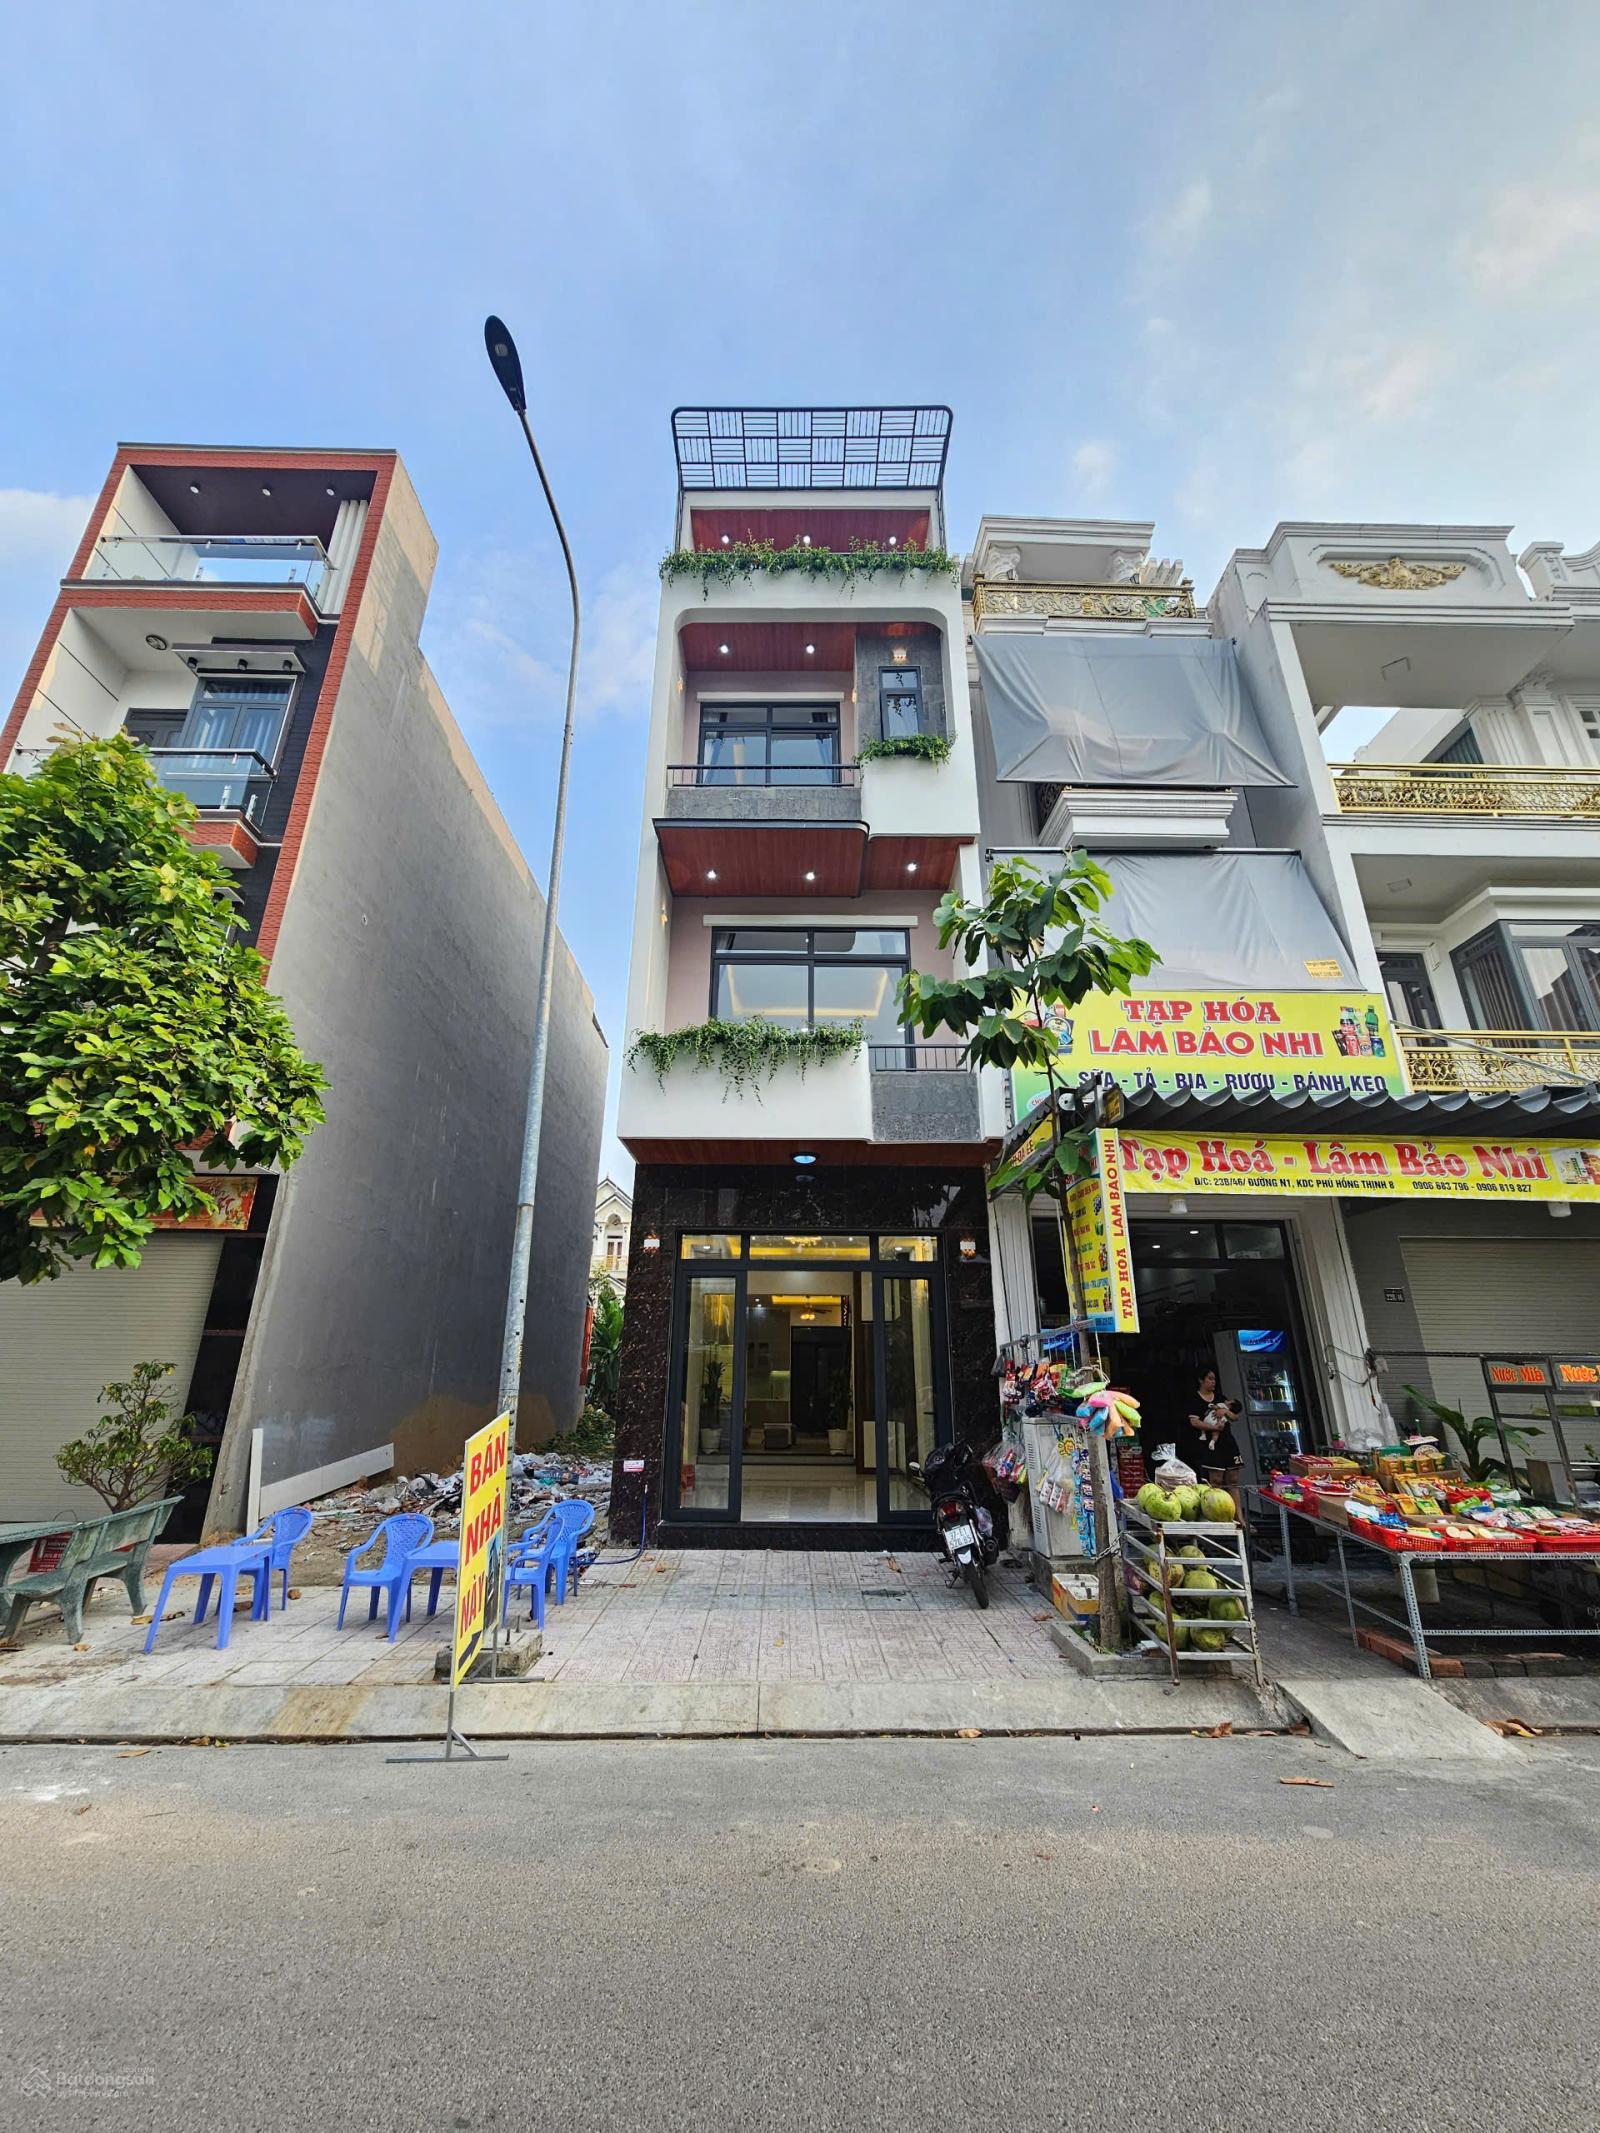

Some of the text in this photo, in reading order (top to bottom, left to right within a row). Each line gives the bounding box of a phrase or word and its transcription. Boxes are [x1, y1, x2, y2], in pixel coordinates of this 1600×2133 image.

[1121, 996, 1281, 1027] TẠP HÓA
[1089, 1025, 1324, 1057] LÂM BẢO NHI
[1175, 1072, 1208, 1089] BIA
[1293, 1071, 1345, 1092] BÁNH
[1104, 1139, 1117, 1164] NHI
[1118, 1139, 1190, 1181] Tạp
[1197, 1139, 1276, 1174] Hoá
[1303, 1141, 1390, 1175] Lâm
[1393, 1141, 1468, 1177] Bảo
[1473, 1145, 1551, 1179] Nhi
[1296, 1178, 1315, 1188] KDC
[1361, 1179, 1388, 1190] THỊNH
[470, 1430, 506, 1497] BÁN
[464, 1486, 501, 1567] NHÀ
[459, 1571, 485, 1640] NÀY
